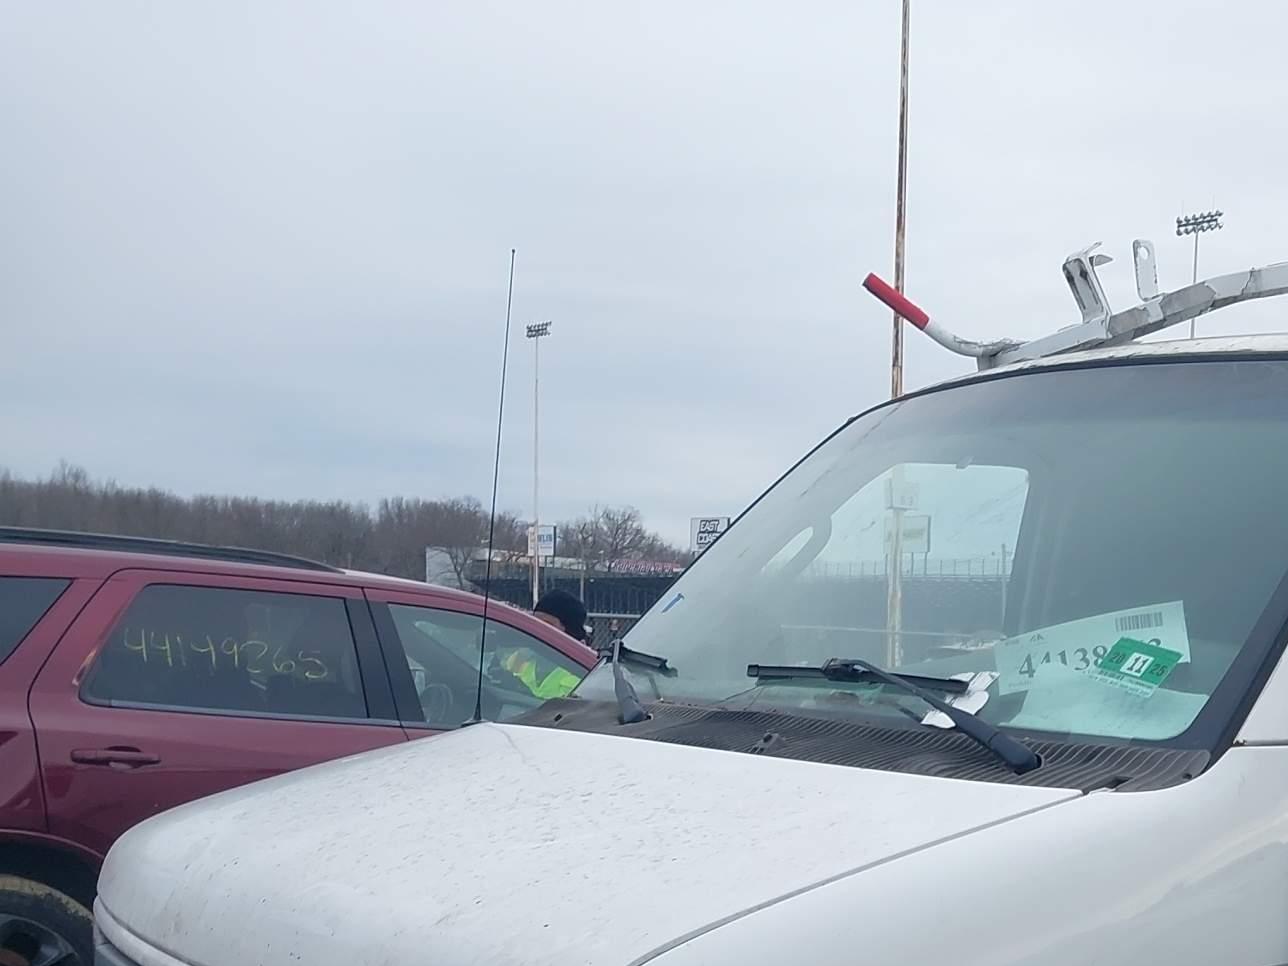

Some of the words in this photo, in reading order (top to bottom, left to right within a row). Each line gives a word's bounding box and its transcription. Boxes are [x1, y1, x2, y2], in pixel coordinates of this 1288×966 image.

[699, 519, 720, 531] EAST
[124, 627, 328, 679] 44149265
[1126, 655, 1150, 674] 11
